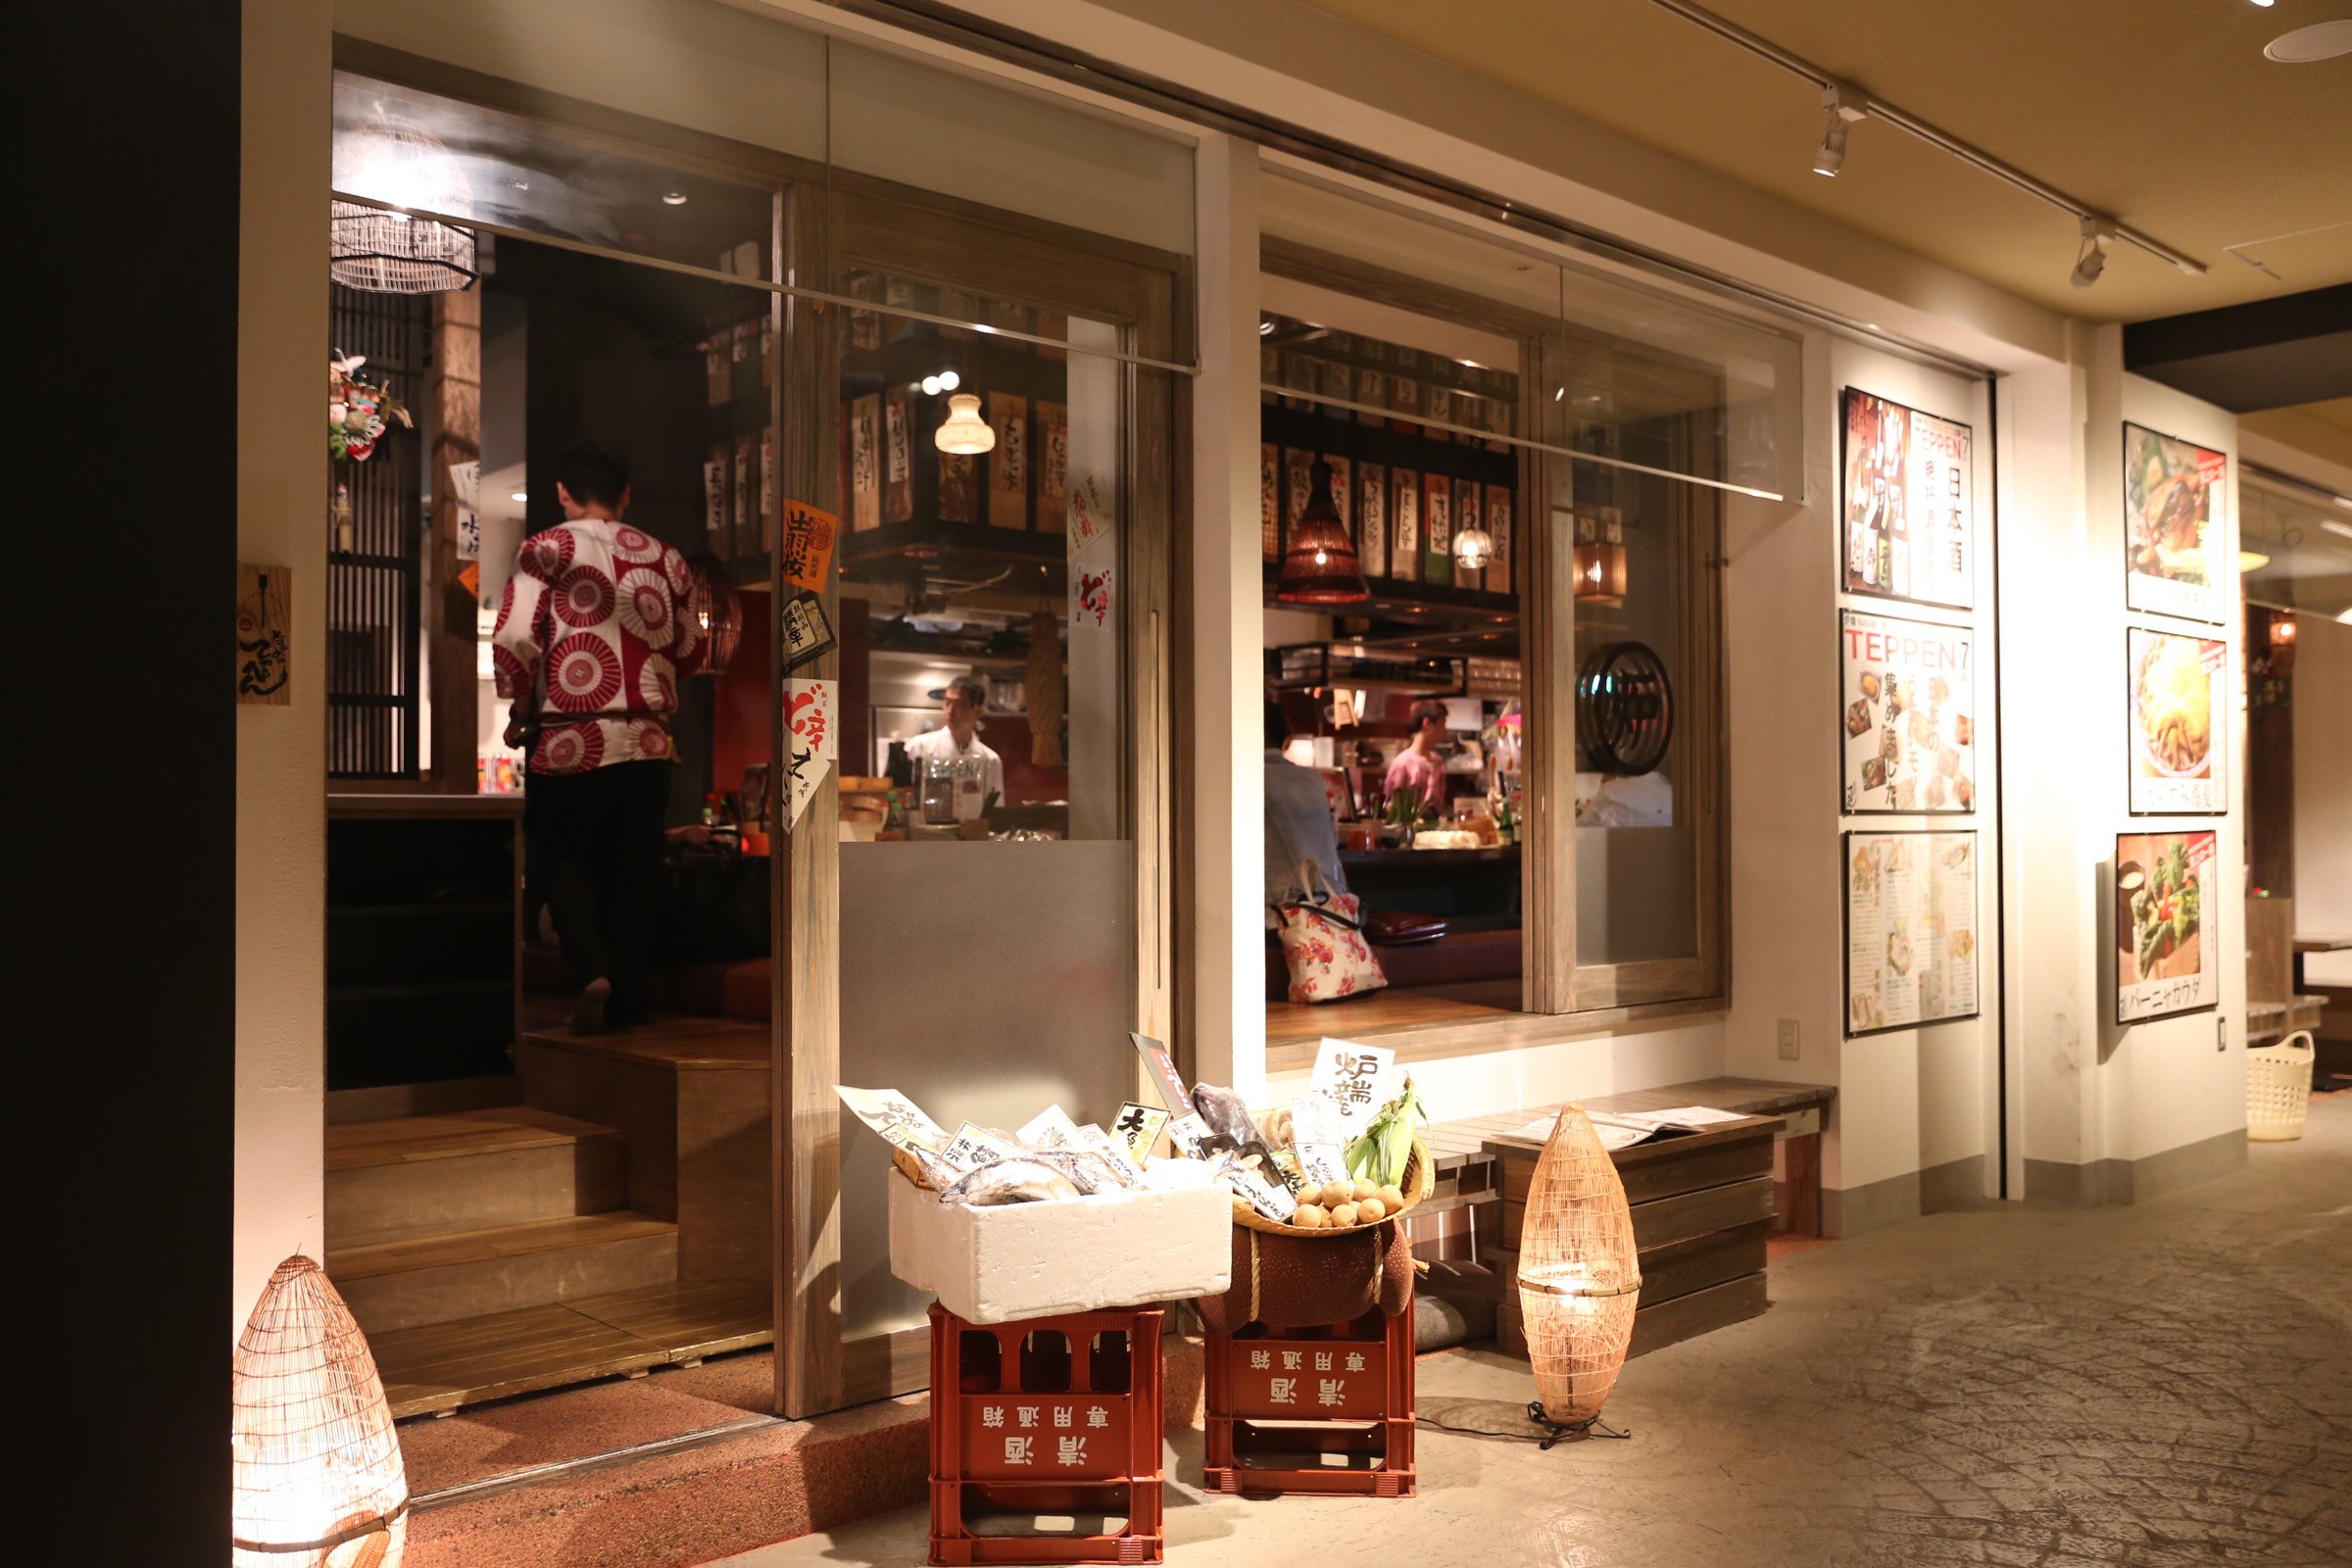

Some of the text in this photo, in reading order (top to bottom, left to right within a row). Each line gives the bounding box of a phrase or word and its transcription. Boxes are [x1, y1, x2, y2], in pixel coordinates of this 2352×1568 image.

[783, 510, 814, 580] 出羽桜
[1844, 629, 1956, 670] TEPPEN
[783, 683, 826, 753] ど辛
[2129, 976, 2202, 1009] バーニャカウダ
[1250, 1349, 1365, 1372] 専用通箱
[1270, 1378, 1346, 1406] 清酒
[982, 1405, 1109, 1429] 専用通箱
[1004, 1436, 1088, 1467] 清酒
